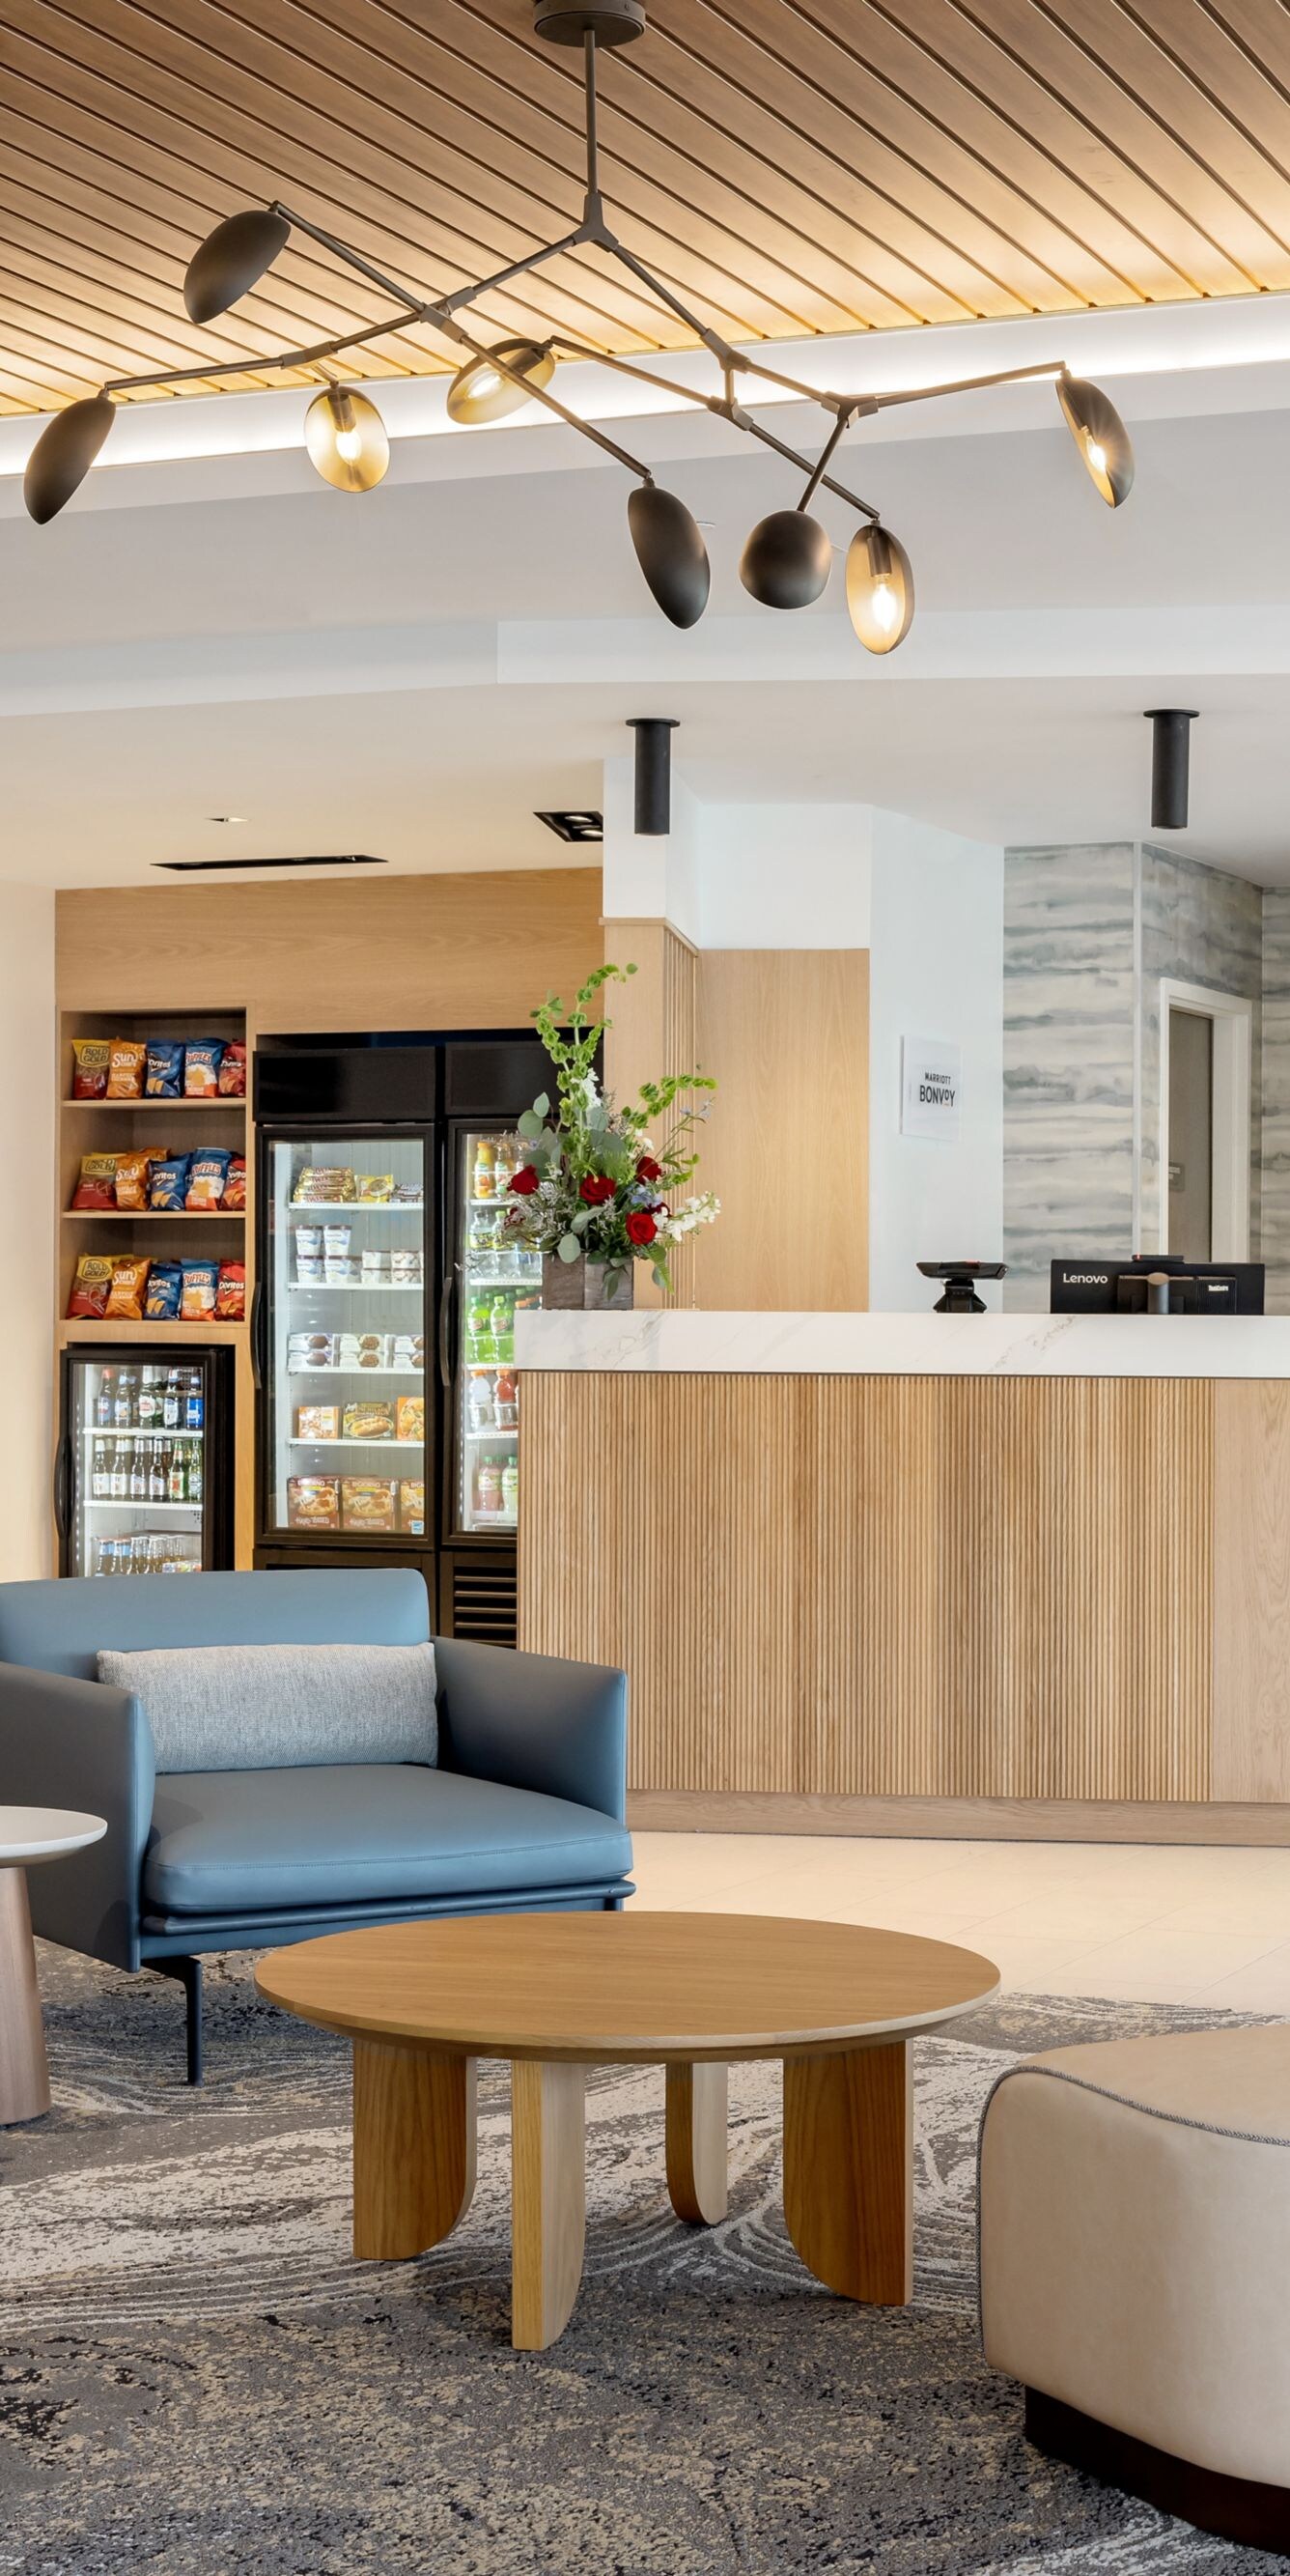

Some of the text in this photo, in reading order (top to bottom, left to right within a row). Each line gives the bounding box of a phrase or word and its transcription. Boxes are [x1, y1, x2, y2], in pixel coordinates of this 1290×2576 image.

[148, 1059, 171, 1068] oritos
[924, 1071, 951, 1085] MARRIOTT
[919, 1085, 956, 1107] BONVOY
[1062, 1272, 1108, 1284] Lenovo
[218, 1282, 245, 1290] Doritos
